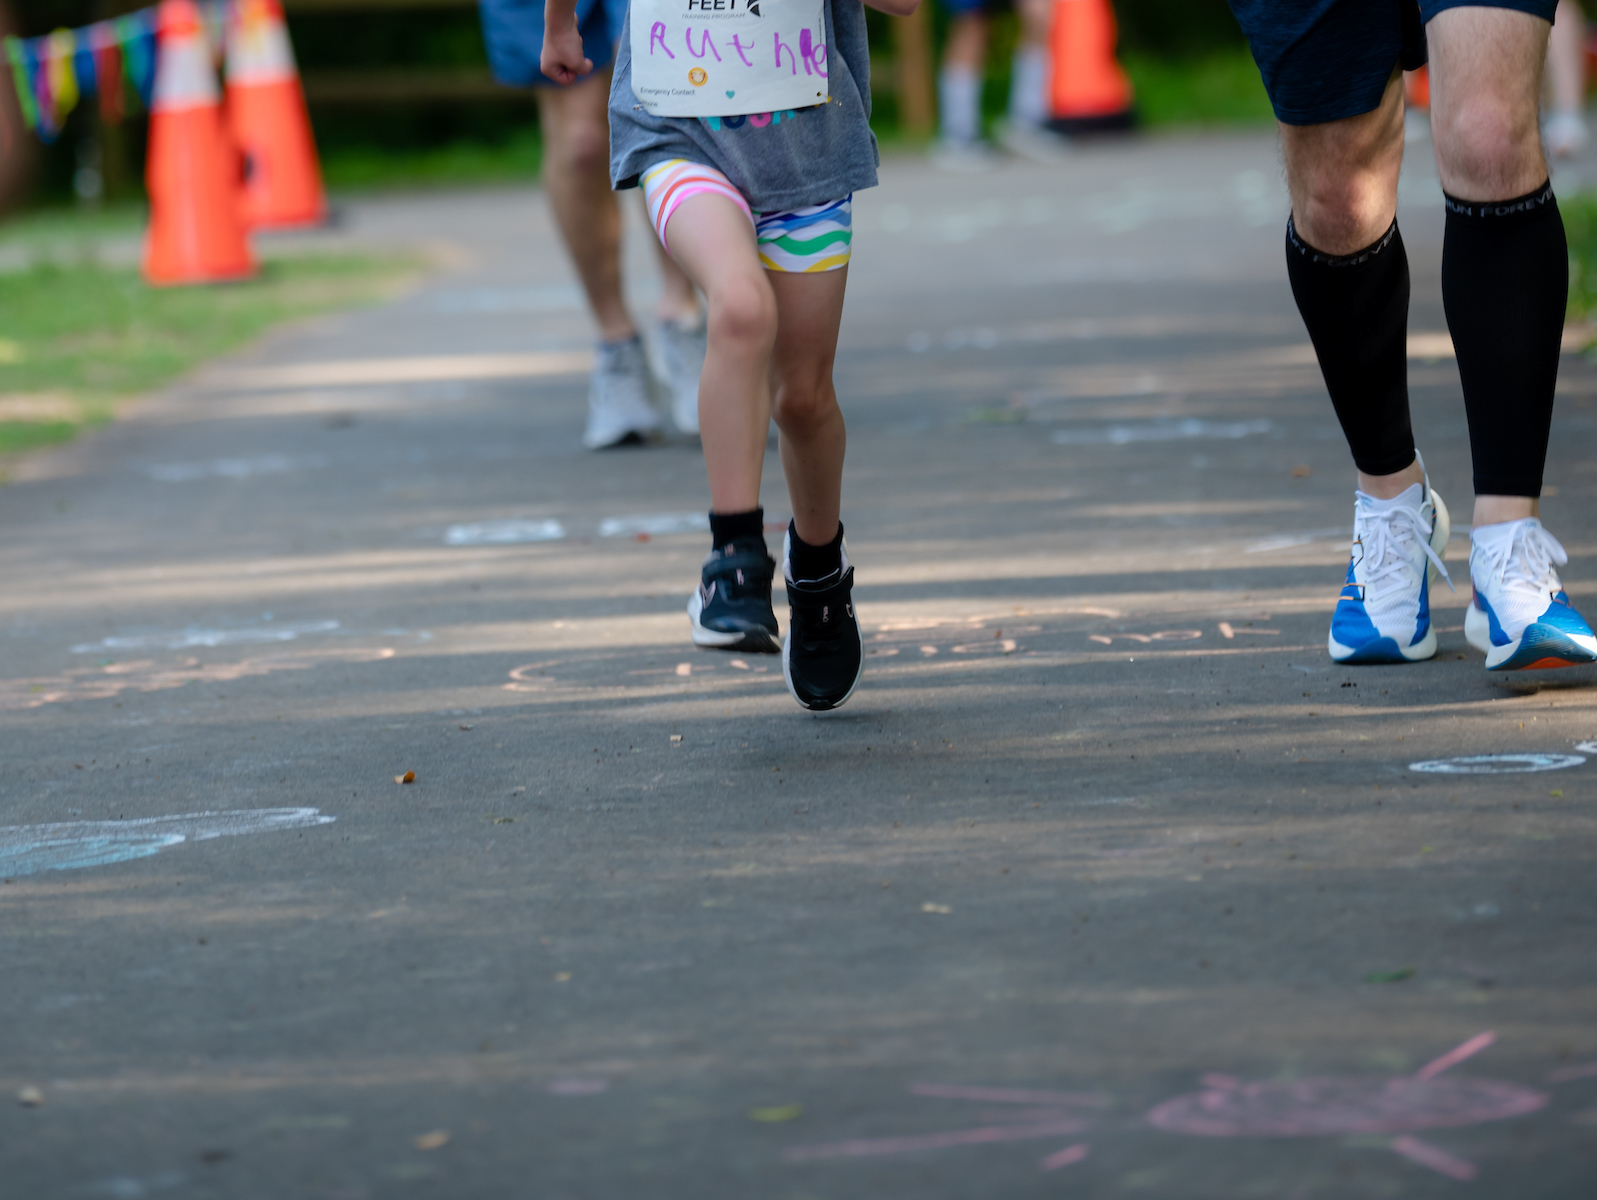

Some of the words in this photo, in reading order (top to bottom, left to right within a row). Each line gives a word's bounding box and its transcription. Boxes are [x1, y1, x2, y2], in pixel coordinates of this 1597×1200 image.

[711, 12, 746, 20] PROGRAM
[640, 86, 671, 96] Emergency
[671, 88, 696, 96] Contact
